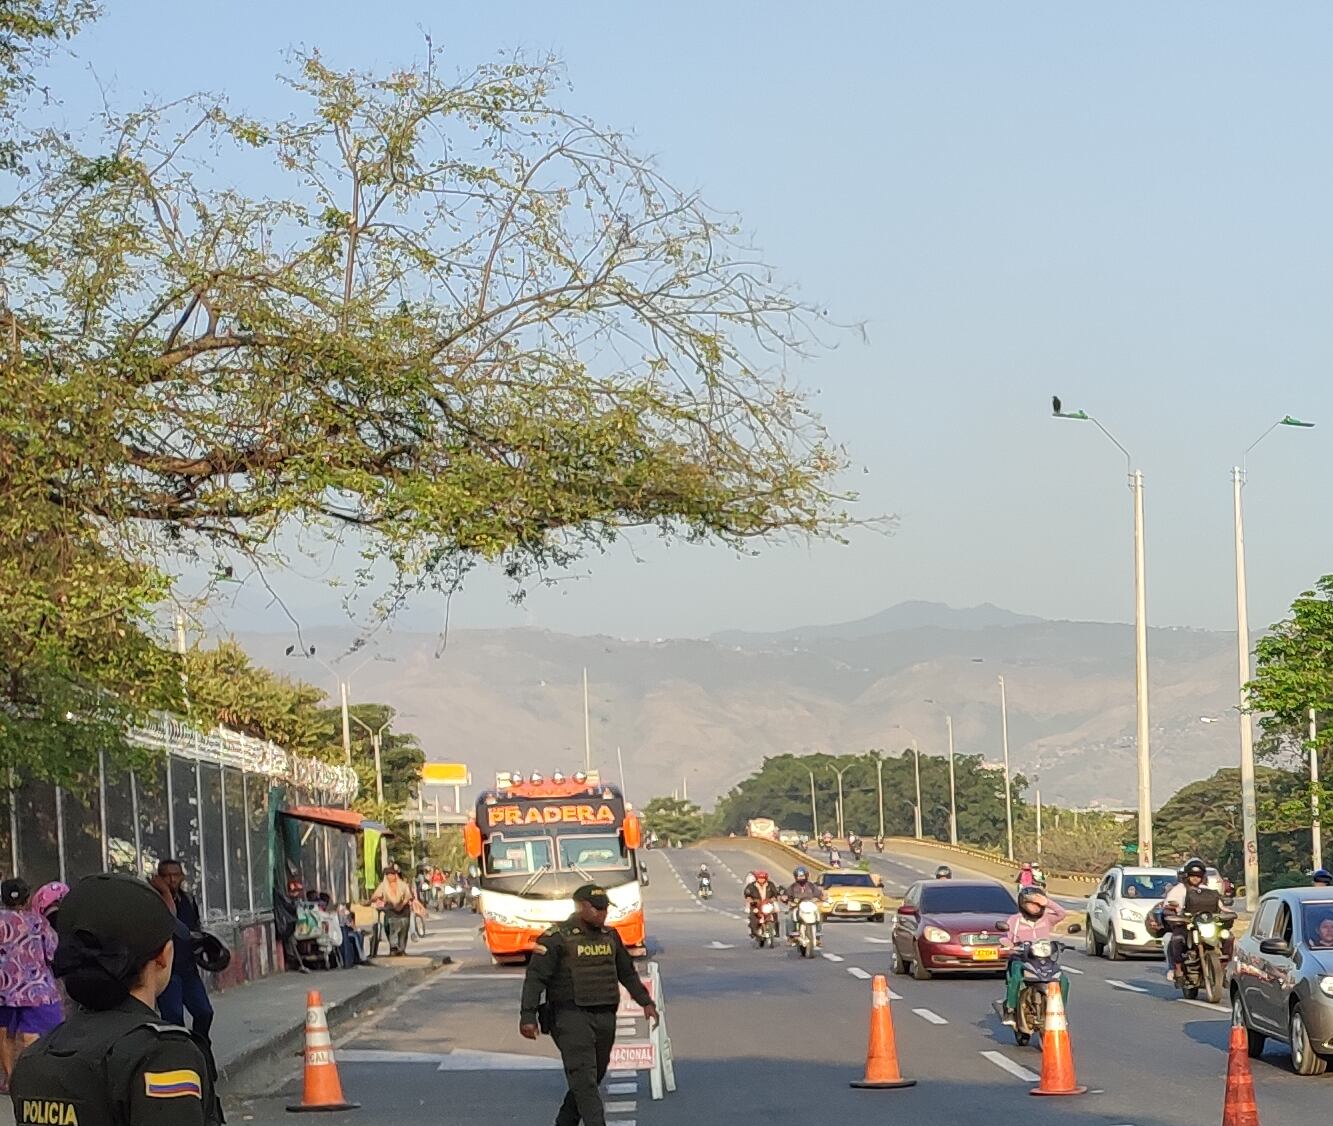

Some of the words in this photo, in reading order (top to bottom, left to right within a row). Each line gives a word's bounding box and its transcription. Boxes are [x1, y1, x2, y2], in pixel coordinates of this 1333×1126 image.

[488, 804, 616, 827] PRADERA
[577, 944, 612, 957] POLICIA
[23, 1101, 78, 1126] POLICIA
